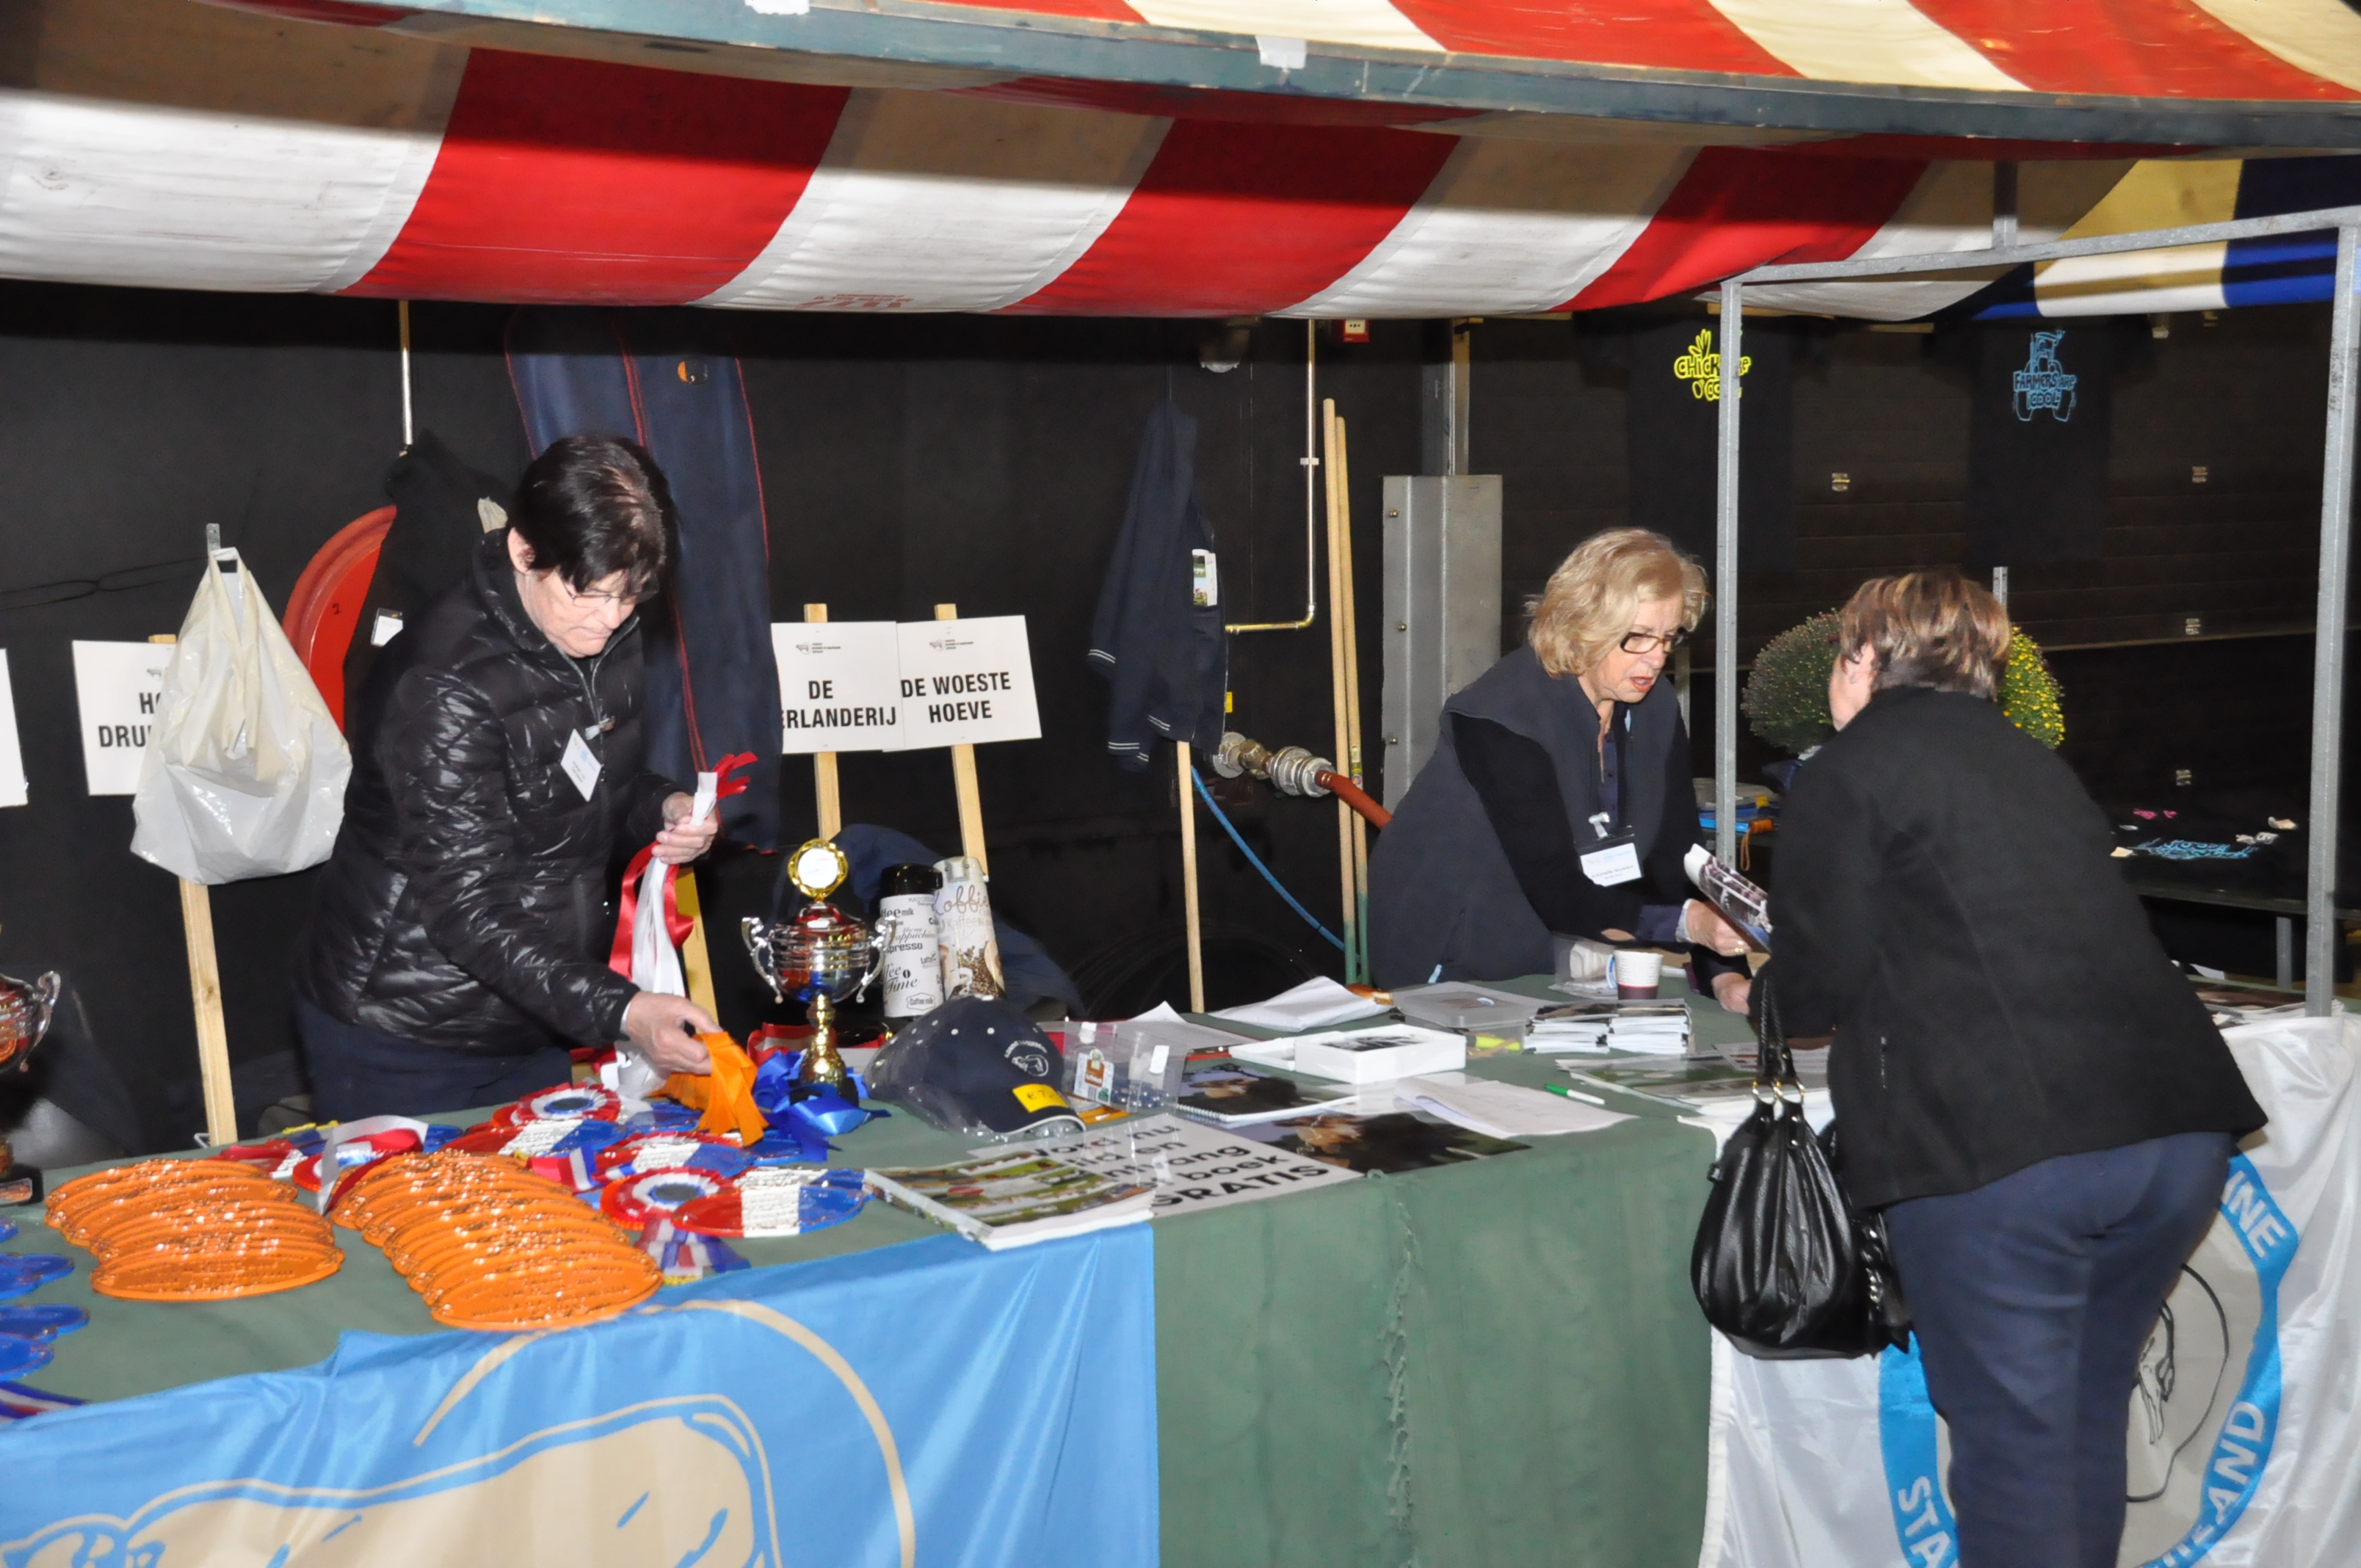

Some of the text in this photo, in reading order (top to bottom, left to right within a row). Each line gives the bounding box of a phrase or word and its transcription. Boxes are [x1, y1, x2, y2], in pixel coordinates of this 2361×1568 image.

[2014, 371, 2059, 392] FARMERS
[2027, 389, 2062, 410] COOL
[808, 680, 833, 699] DE
[901, 672, 1011, 697] DE WOESTE
[929, 700, 992, 723] HOEVE
[98, 725, 151, 747] DRU
[910, 998, 925, 1006] Coffee
[1127, 1125, 1180, 1140] nu
[1135, 1141, 1187, 1155] en
[1176, 1155, 1290, 1181] boek
[1151, 1165, 1330, 1207] GRATIS
